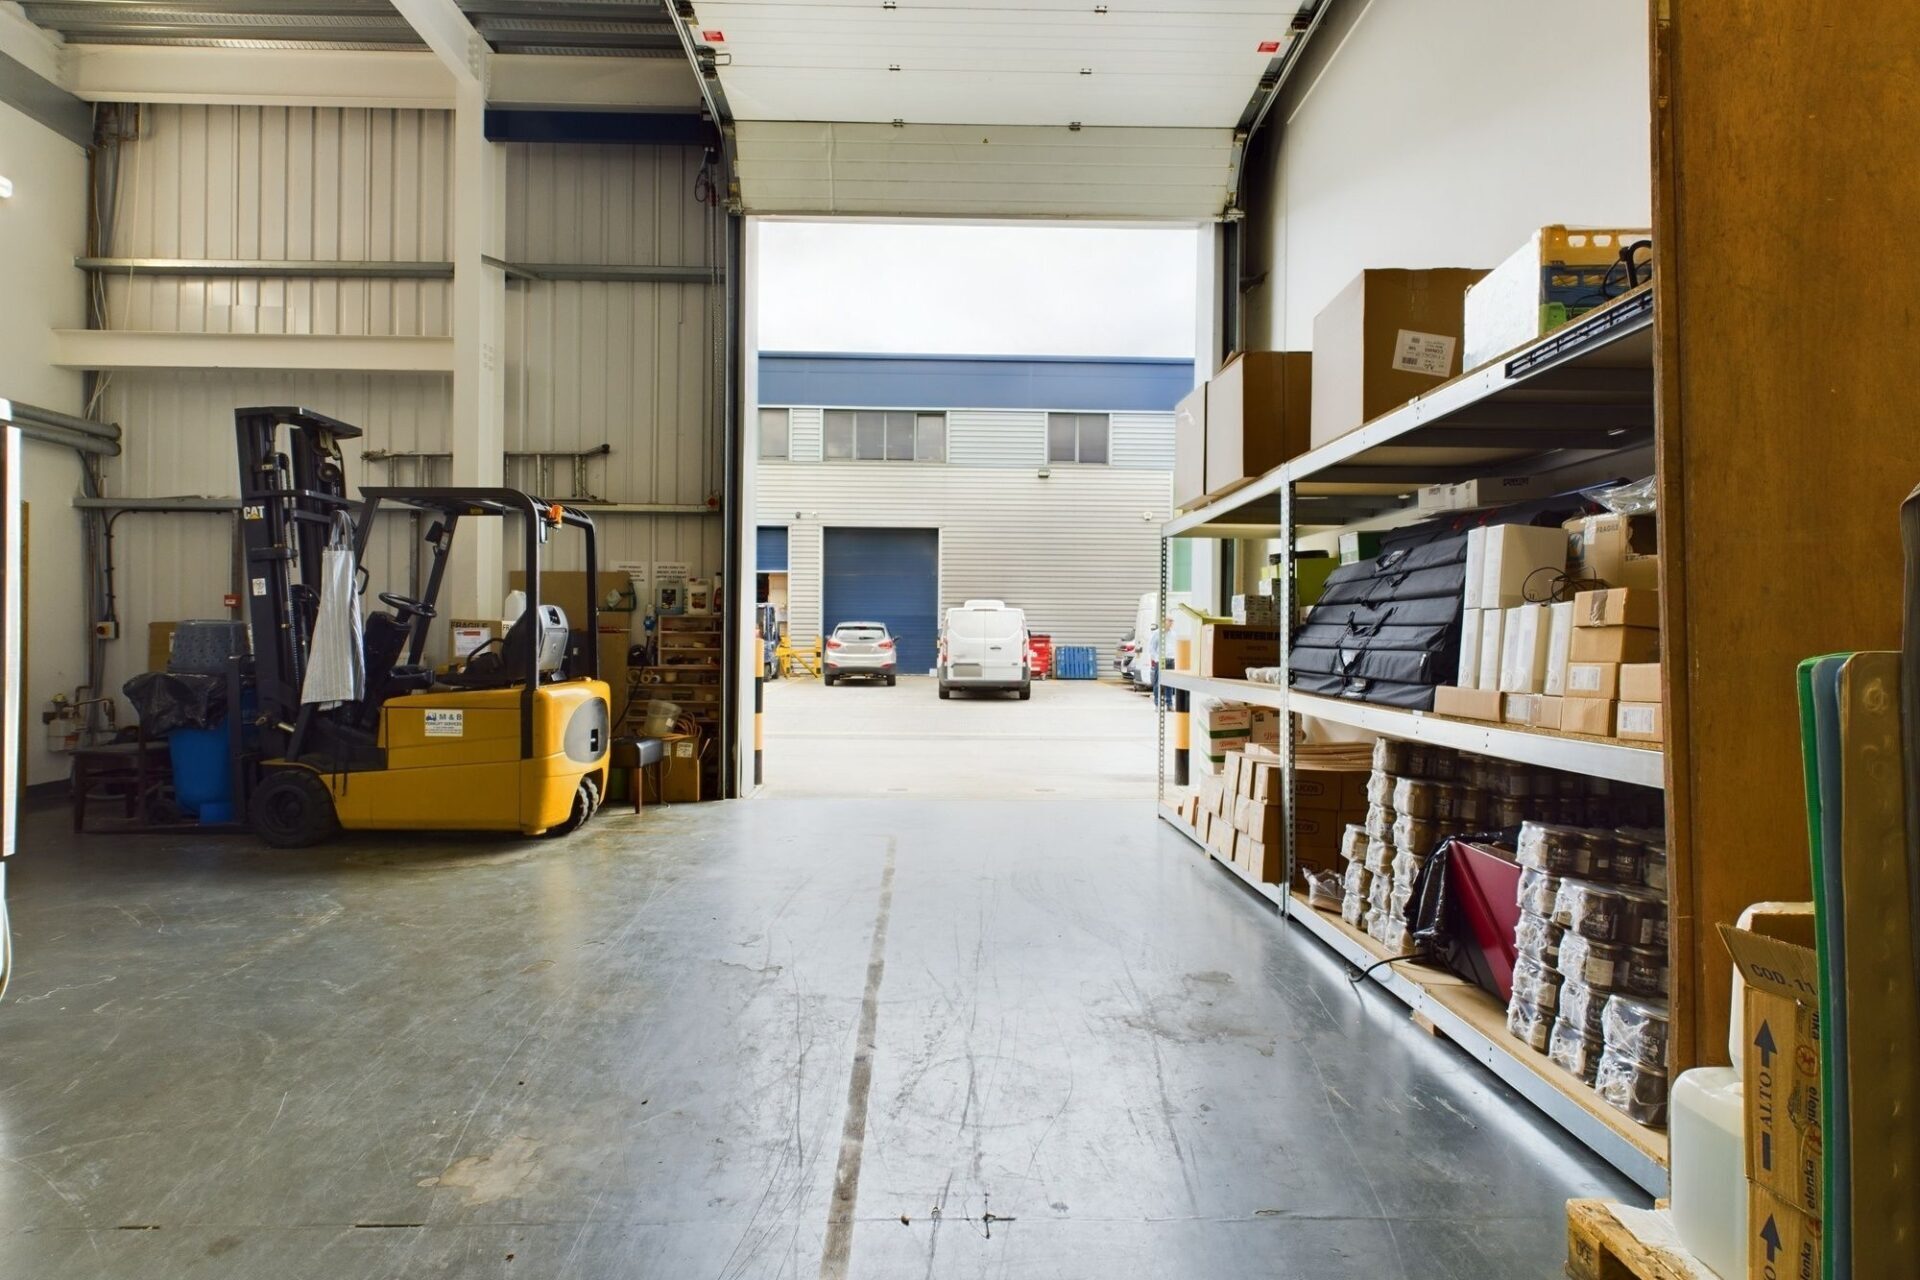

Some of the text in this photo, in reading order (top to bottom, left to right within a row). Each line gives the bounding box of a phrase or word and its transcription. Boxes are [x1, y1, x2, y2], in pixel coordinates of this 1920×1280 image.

[243, 506, 265, 520] CAT
[450, 621, 488, 629] FRAGILE
[1759, 1071, 1773, 1130] ALTO
[1804, 1159, 1815, 1210] elenka
